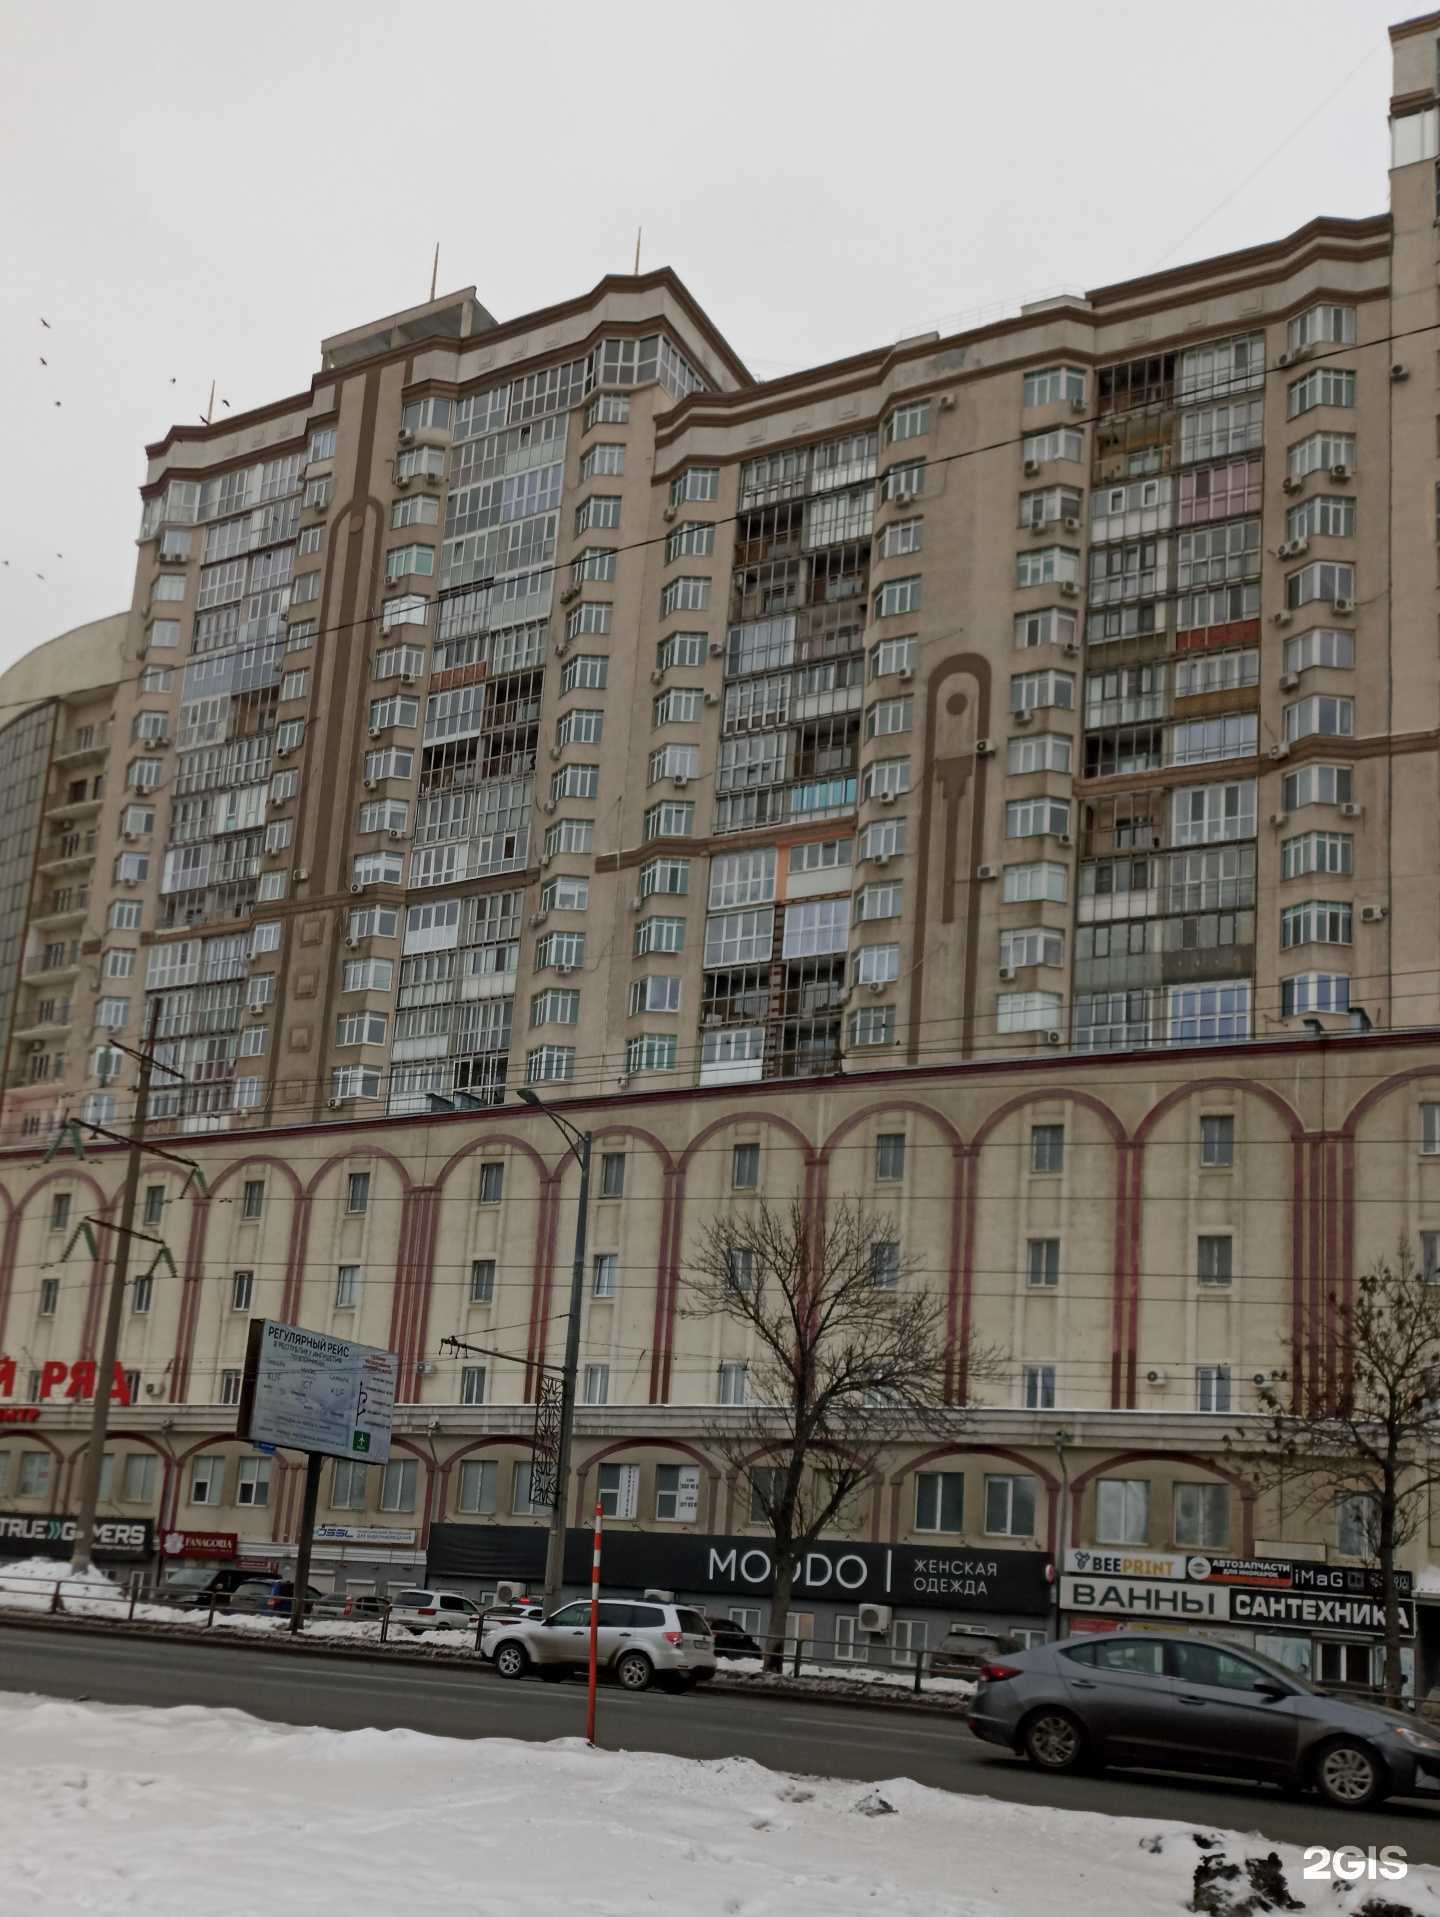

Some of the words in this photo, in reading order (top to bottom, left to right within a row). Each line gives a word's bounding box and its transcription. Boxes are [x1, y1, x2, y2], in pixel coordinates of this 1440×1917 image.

[268, 1326, 326, 1352] РЕГУЛЯРНЫЙ
[327, 1342, 350, 1359] РЕЙС
[0, 1518, 48, 1540] TRUE
[913, 1559, 998, 1577] ЖЕНСКАЯ
[1212, 1559, 1290, 1573] АВТОЗАПЧАСТИ
[913, 1577, 988, 1596] ОДЕЖДА
[1072, 1583, 1215, 1615] ВАННЫ
